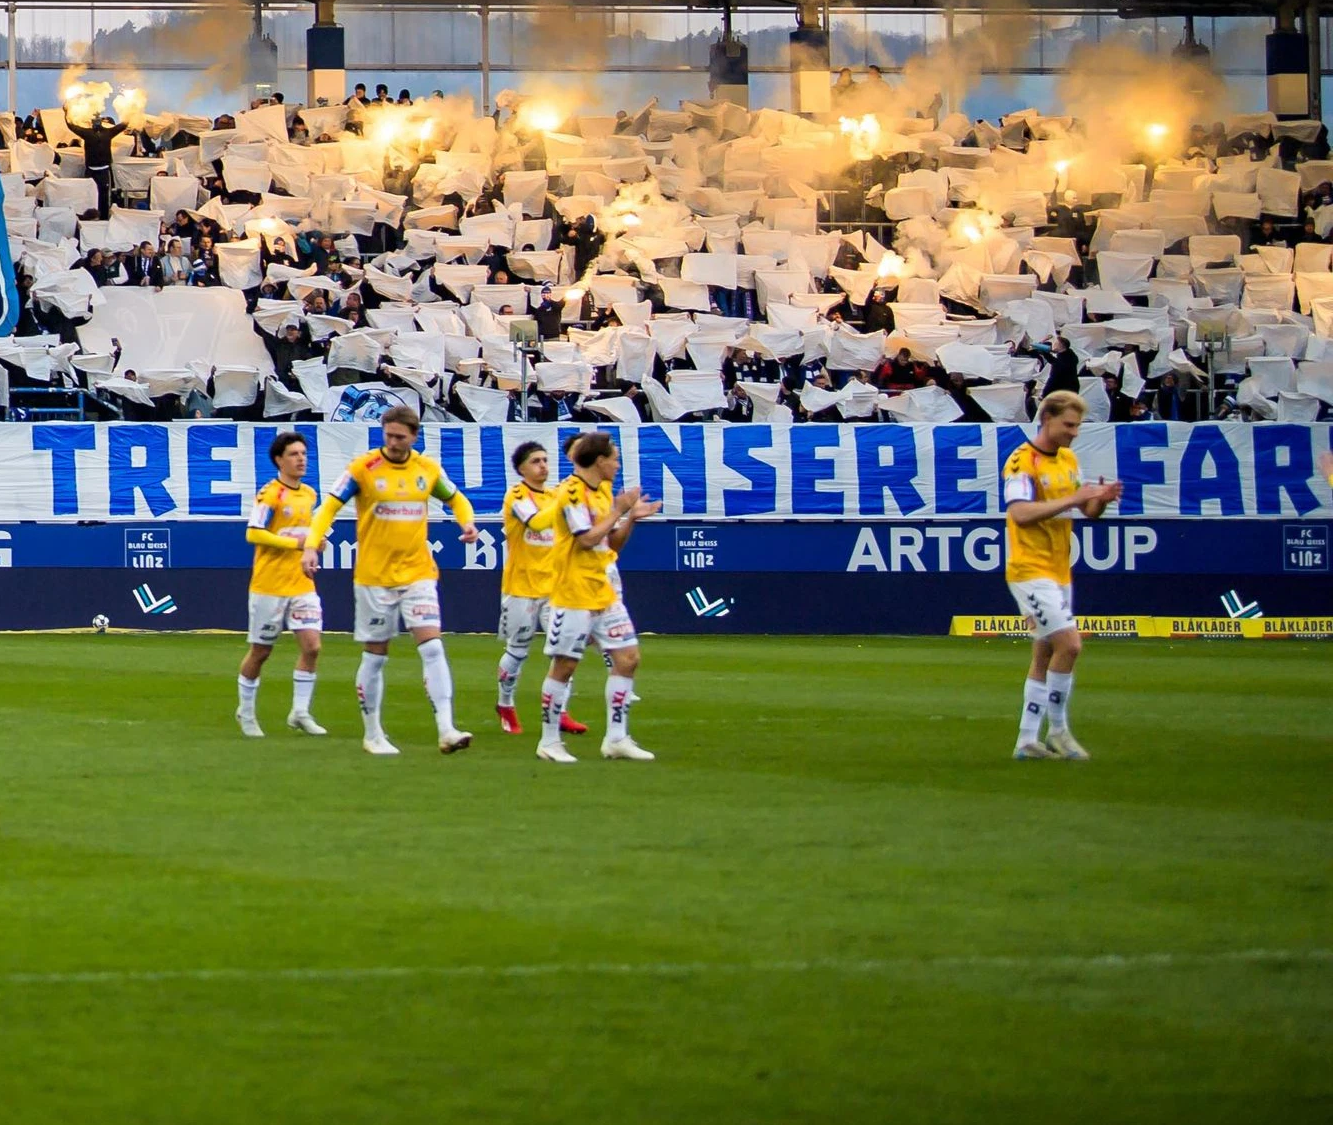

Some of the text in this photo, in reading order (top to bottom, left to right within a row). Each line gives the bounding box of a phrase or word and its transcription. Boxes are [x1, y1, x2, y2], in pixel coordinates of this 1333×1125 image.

[368, 425, 505, 516] U
[1115, 422, 1333, 517] FAR
[141, 532, 153, 541] FC
[692, 530, 704, 539] FC
[846, 526, 1157, 572] ARTGUP
[974, 617, 1028, 632] BLÅKLÄD
[1076, 617, 1137, 631] LÅKLÄDER
[1172, 619, 1242, 633] BLÅKLÄDER
[1264, 619, 1333, 633] BLÅKLÄDER
